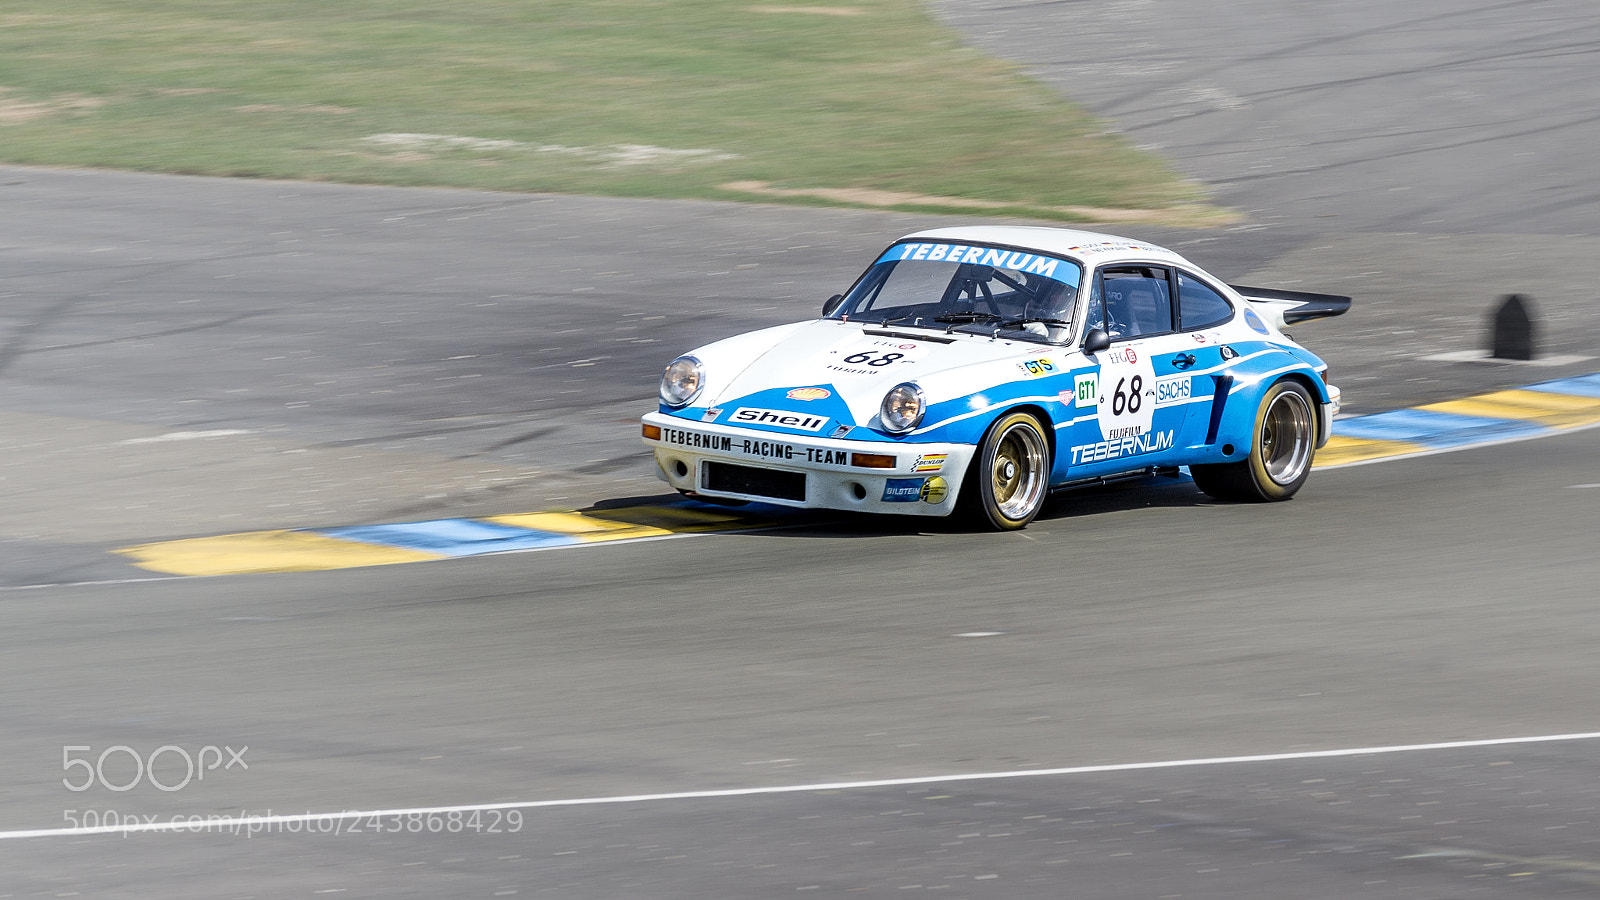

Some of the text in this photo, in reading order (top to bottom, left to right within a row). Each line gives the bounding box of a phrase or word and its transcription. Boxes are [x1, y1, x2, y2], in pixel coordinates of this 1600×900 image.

[900, 244, 1059, 277] TEBERNUM
[843, 350, 904, 367] 68
[1024, 359, 1053, 374] GTS
[1078, 380, 1095, 401] GT1
[1112, 374, 1143, 416] 68
[1158, 380, 1190, 401] SACHS
[736, 410, 822, 429] Shell
[1109, 425, 1141, 439] FUJIFILM
[1070, 429, 1174, 465] TEBERNUM
[886, 487, 920, 495] BILSTEIN
